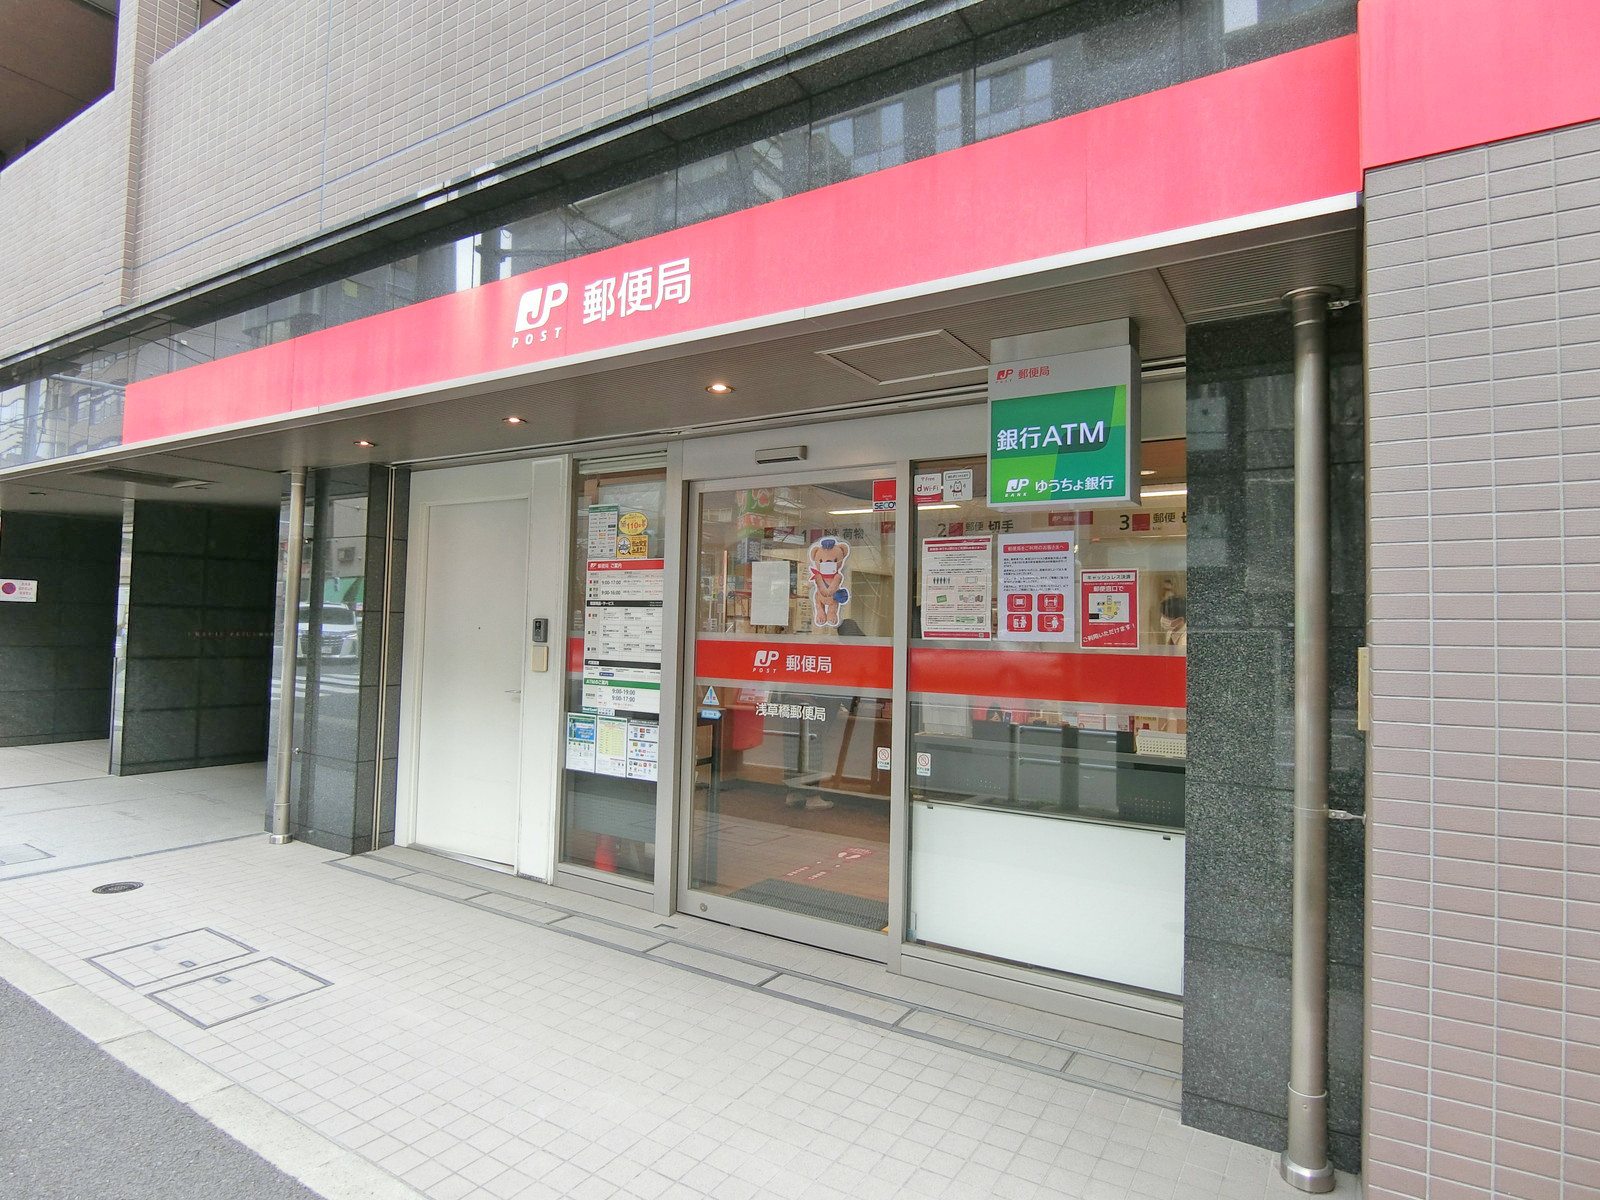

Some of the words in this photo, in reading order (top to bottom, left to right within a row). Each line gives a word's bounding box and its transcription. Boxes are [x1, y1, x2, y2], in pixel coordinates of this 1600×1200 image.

[582, 257, 692, 325] 郵便局
[511, 326, 563, 349] POST
[1017, 365, 1050, 380] 郵便局
[996, 420, 1105, 451] 銀行ATM
[1035, 475, 1114, 494] ゆうちょ銀行
[937, 523, 947, 538] 2
[965, 521, 984, 533] 郵便
[988, 519, 1014, 533] 切手
[1119, 514, 1130, 530] 3
[1153, 512, 1176, 524] 郵便
[785, 655, 832, 674] 郵便局
[755, 702, 826, 722] 浅草橋郵便局
